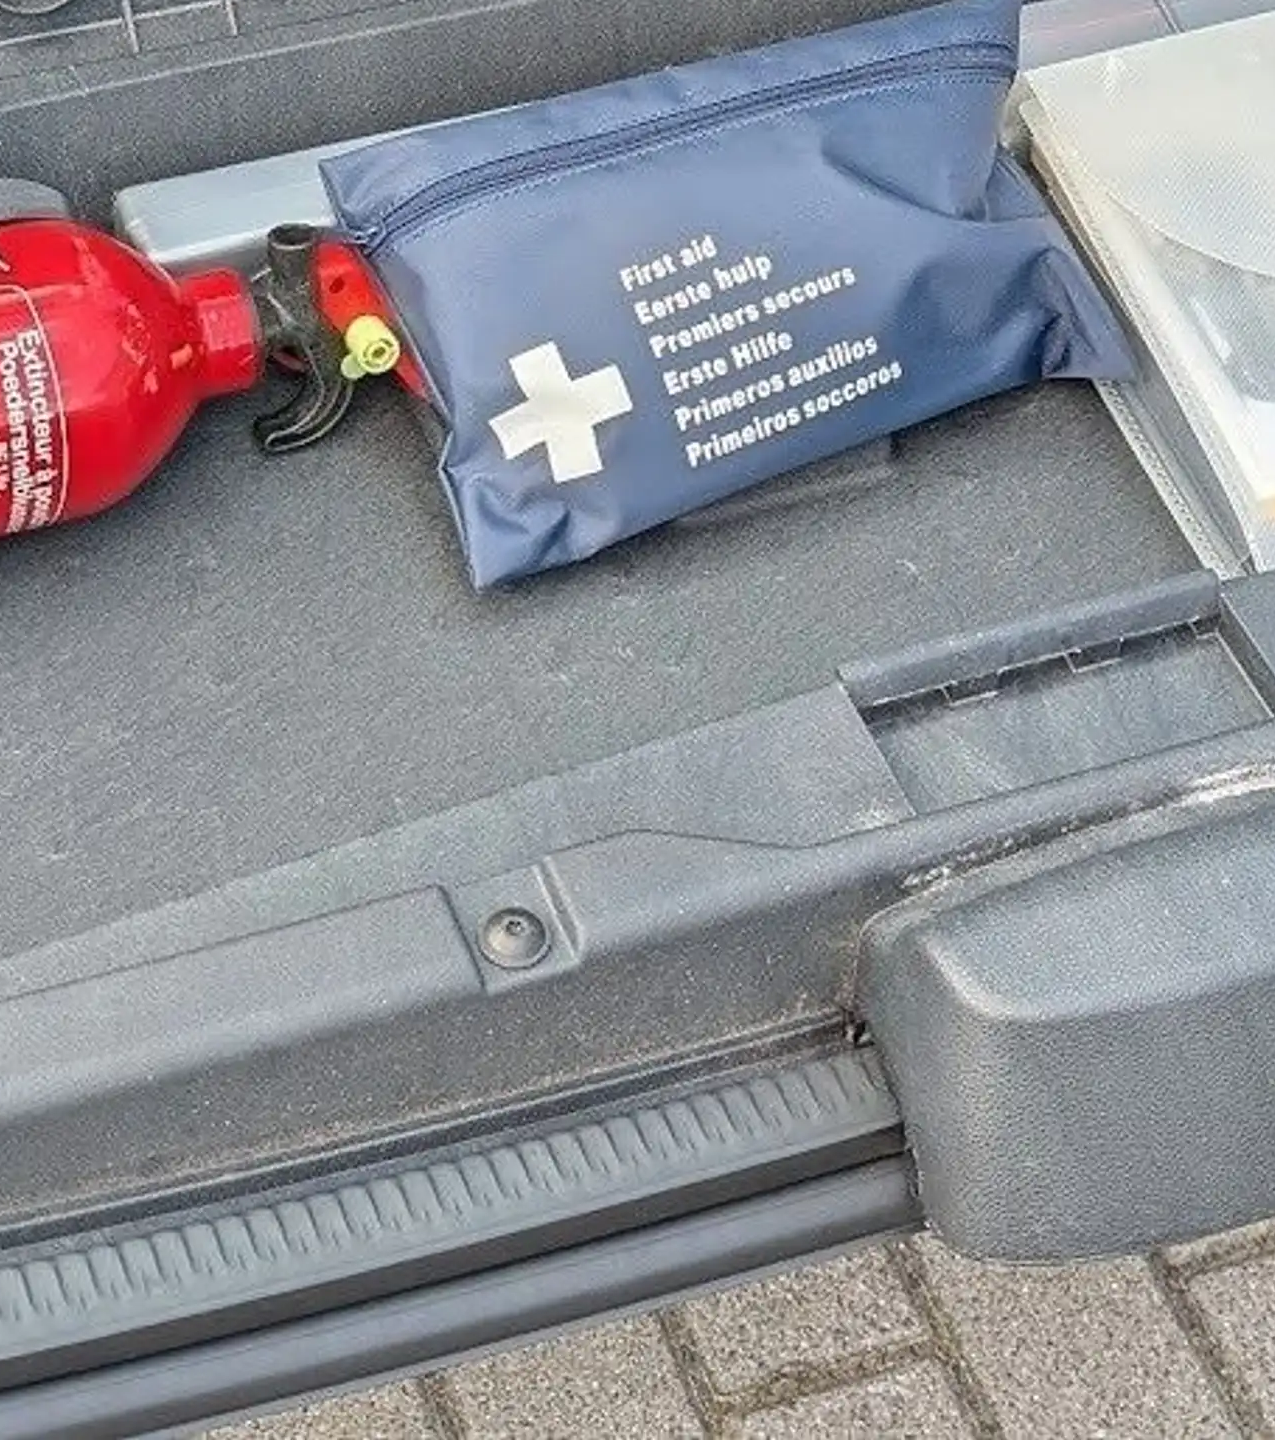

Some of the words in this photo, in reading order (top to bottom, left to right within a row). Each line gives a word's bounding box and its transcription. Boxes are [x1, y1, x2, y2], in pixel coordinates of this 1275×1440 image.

[620, 252, 678, 292] First
[677, 234, 718, 268] aid
[633, 280, 712, 326] Eerste
[712, 254, 774, 291] hulp
[648, 300, 760, 359] Premiers
[762, 266, 857, 315] secours
[17, 329, 54, 467] Extincteur
[661, 354, 729, 396] Erste
[729, 329, 794, 371] Hilfe
[674, 371, 786, 432] Primeros
[786, 334, 879, 388] auxilios
[685, 406, 802, 469] Primeiros
[802, 359, 904, 421] soccoros
